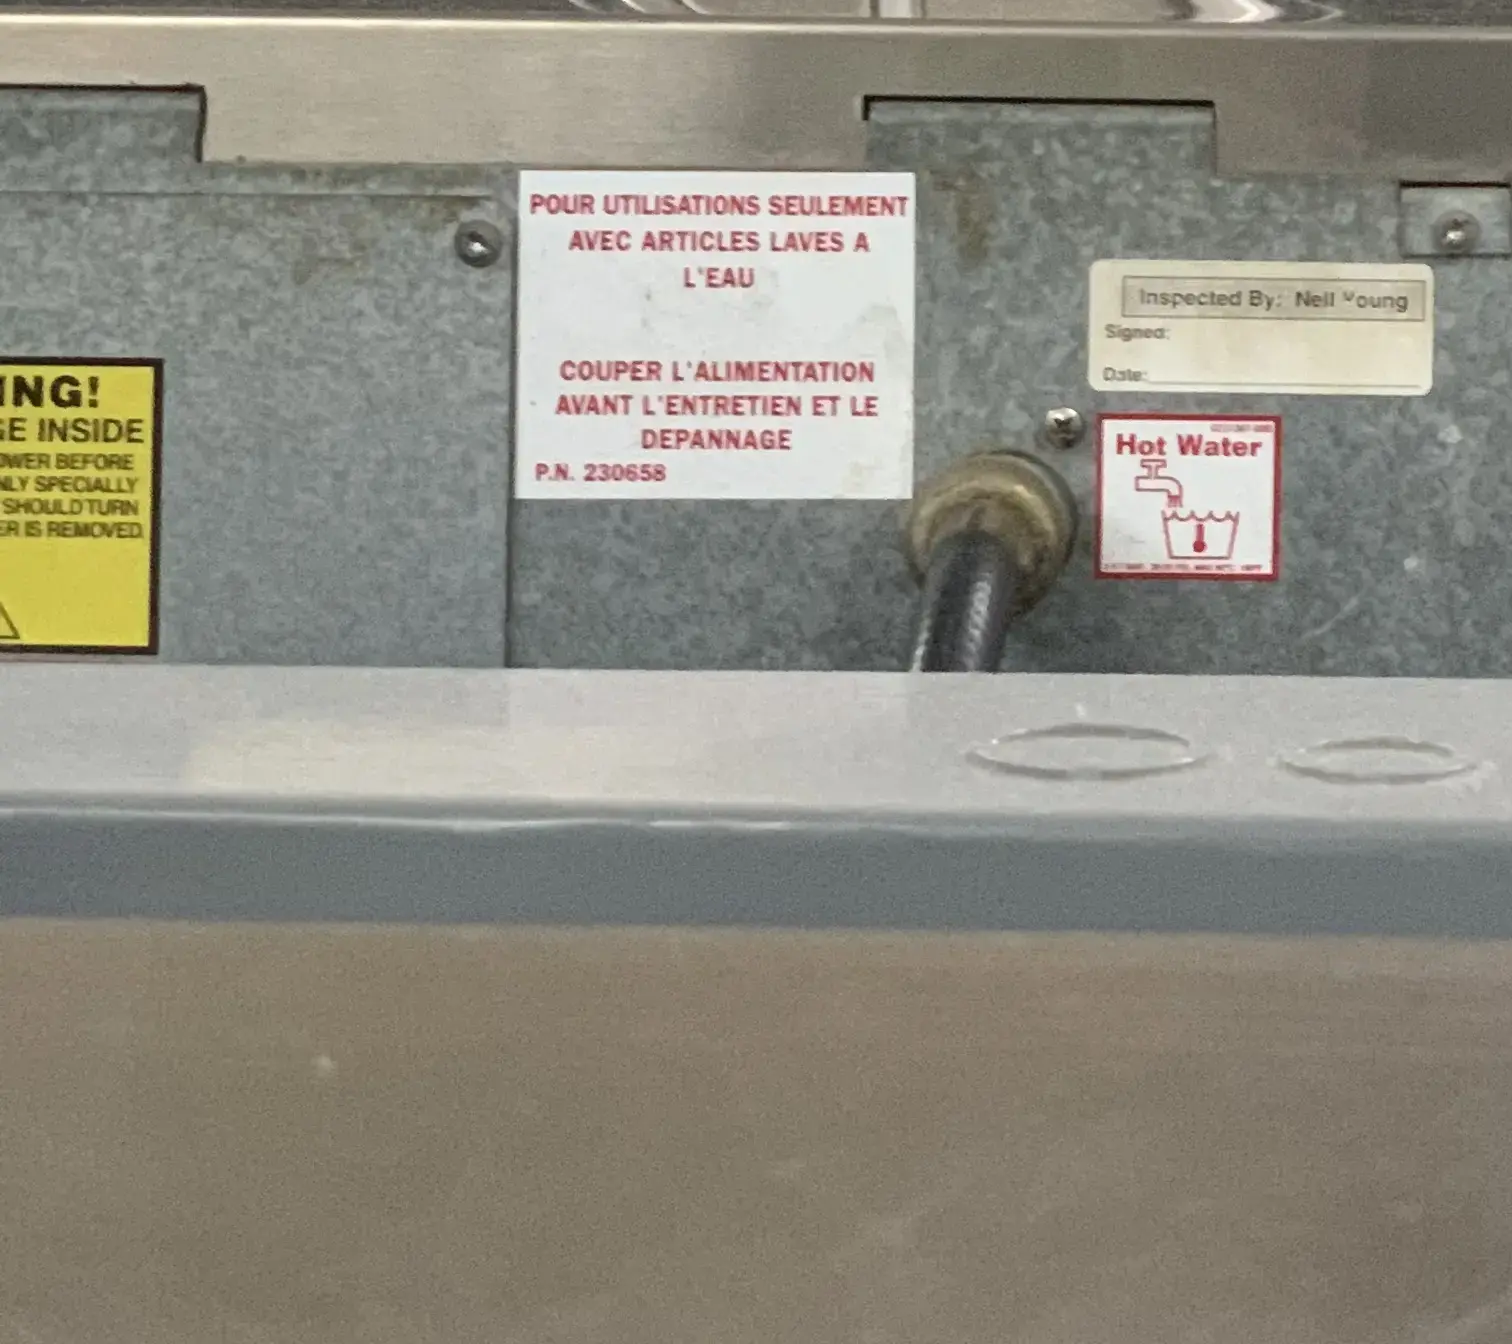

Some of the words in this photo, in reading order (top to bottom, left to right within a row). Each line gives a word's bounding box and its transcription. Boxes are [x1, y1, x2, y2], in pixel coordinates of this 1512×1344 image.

[529, 193, 595, 216] POUR
[602, 193, 761, 216] UTILISATIONS
[769, 195, 908, 217] SEULEMENT
[569, 230, 631, 252] AVEC
[642, 230, 758, 252] ARTICLES
[772, 230, 844, 252] LAVES
[853, 231, 870, 252] A
[684, 267, 755, 289] L'EAU
[1139, 289, 1242, 308] Inspected
[1249, 290, 1282, 311] By:
[1342, 291, 1409, 313] Young
[559, 360, 663, 382] COUPER
[672, 360, 874, 383] L'ALIMENTATION
[555, 394, 633, 416] AVANT
[641, 394, 802, 417] L'ENTRETIEN
[812, 395, 840, 416] ET
[850, 396, 877, 418] LE
[38, 418, 144, 443] INSIDE
[642, 427, 790, 450] DEPANNAGE
[1115, 433, 1167, 456] Hot
[1177, 434, 1263, 457] Water
[55, 453, 134, 471] BEFORE
[535, 463, 575, 481] P.N.
[584, 463, 667, 482] 230658
[34, 476, 139, 493] SPECIALLY
[2, 498, 83, 515] SHOULD
[84, 499, 139, 516] TURN
[24, 520, 42, 537] IS
